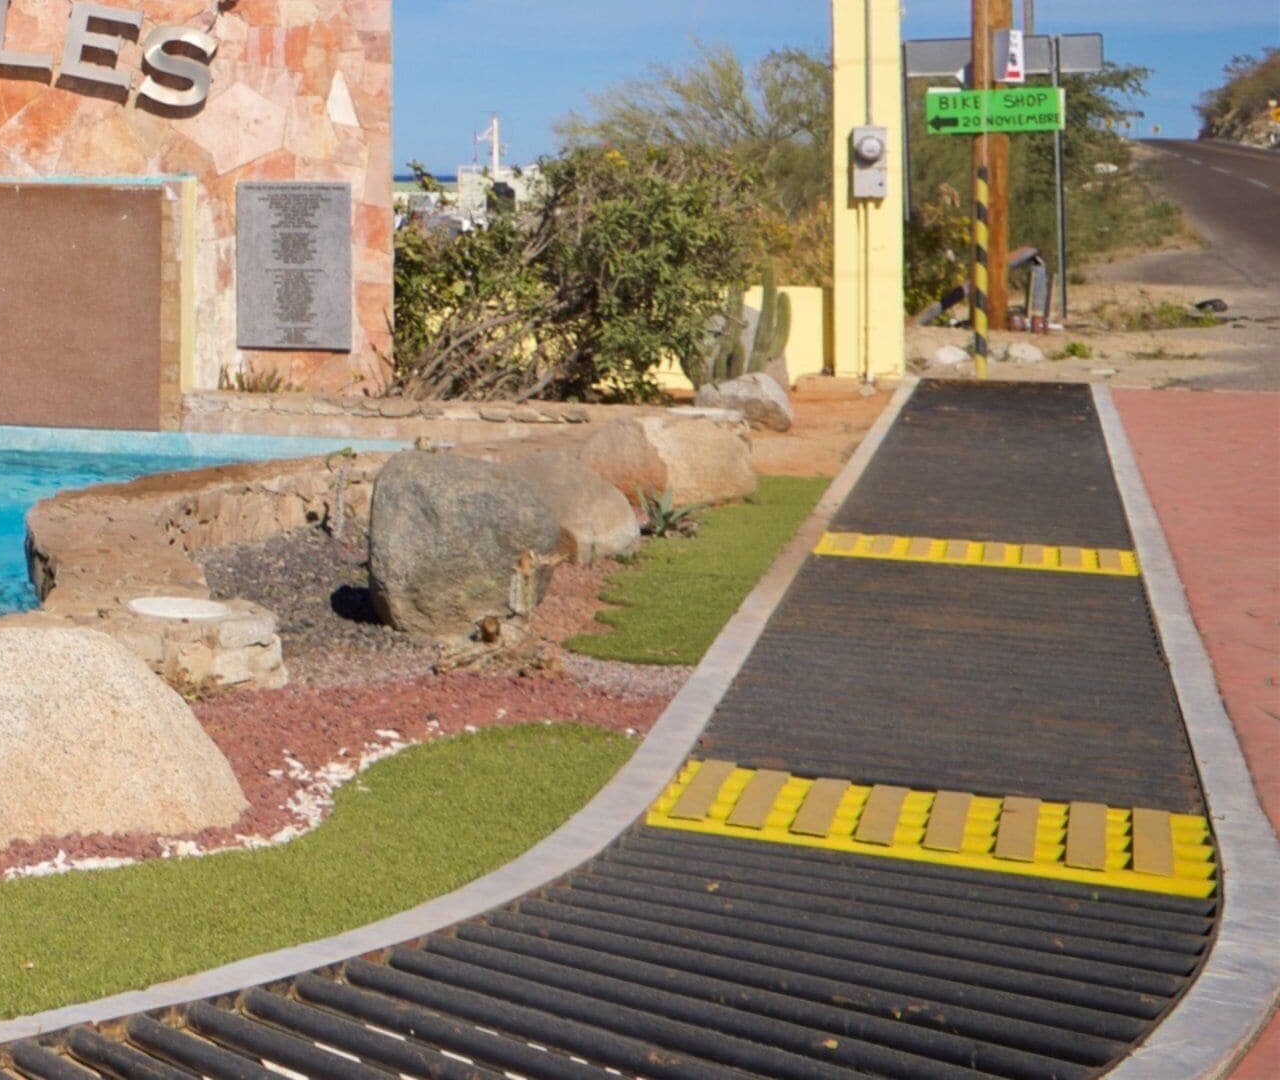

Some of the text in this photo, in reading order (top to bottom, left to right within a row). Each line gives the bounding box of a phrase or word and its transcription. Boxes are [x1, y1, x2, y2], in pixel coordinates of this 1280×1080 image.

[938, 93, 1049, 110] BIKE SHOP
[962, 112, 1060, 128] 20 NOVIEMBRE
